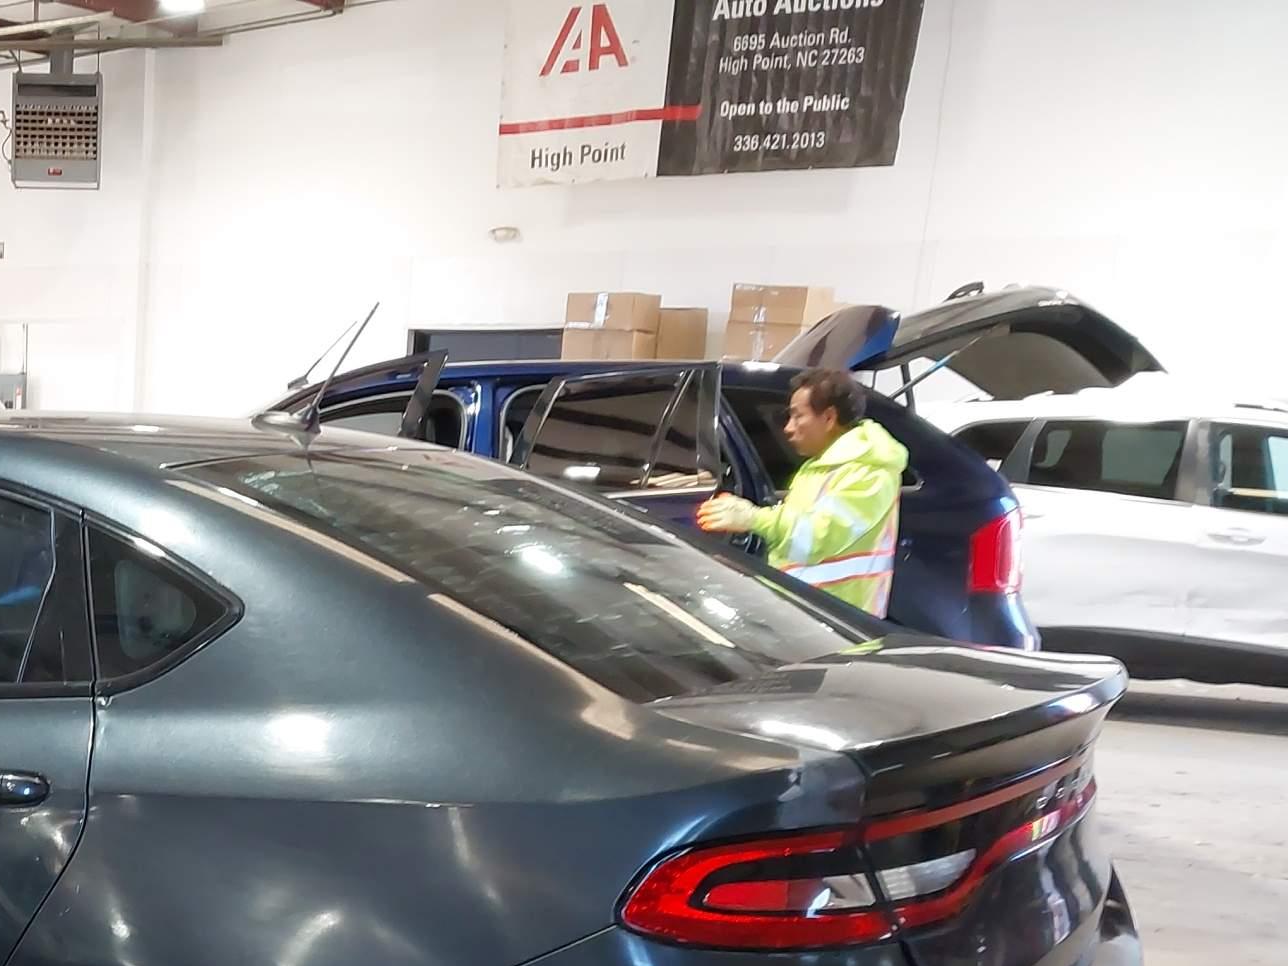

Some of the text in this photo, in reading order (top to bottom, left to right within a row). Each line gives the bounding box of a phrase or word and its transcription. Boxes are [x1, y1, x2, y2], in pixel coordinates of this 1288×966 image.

[712, 0, 767, 21] Auto
[733, 26, 852, 51] 6695 Auction Rd.
[719, 47, 865, 75] High Point, NC 27263
[720, 94, 850, 120] Open to the Public
[733, 132, 826, 151] 336.421.2013
[530, 141, 626, 172] High Point
